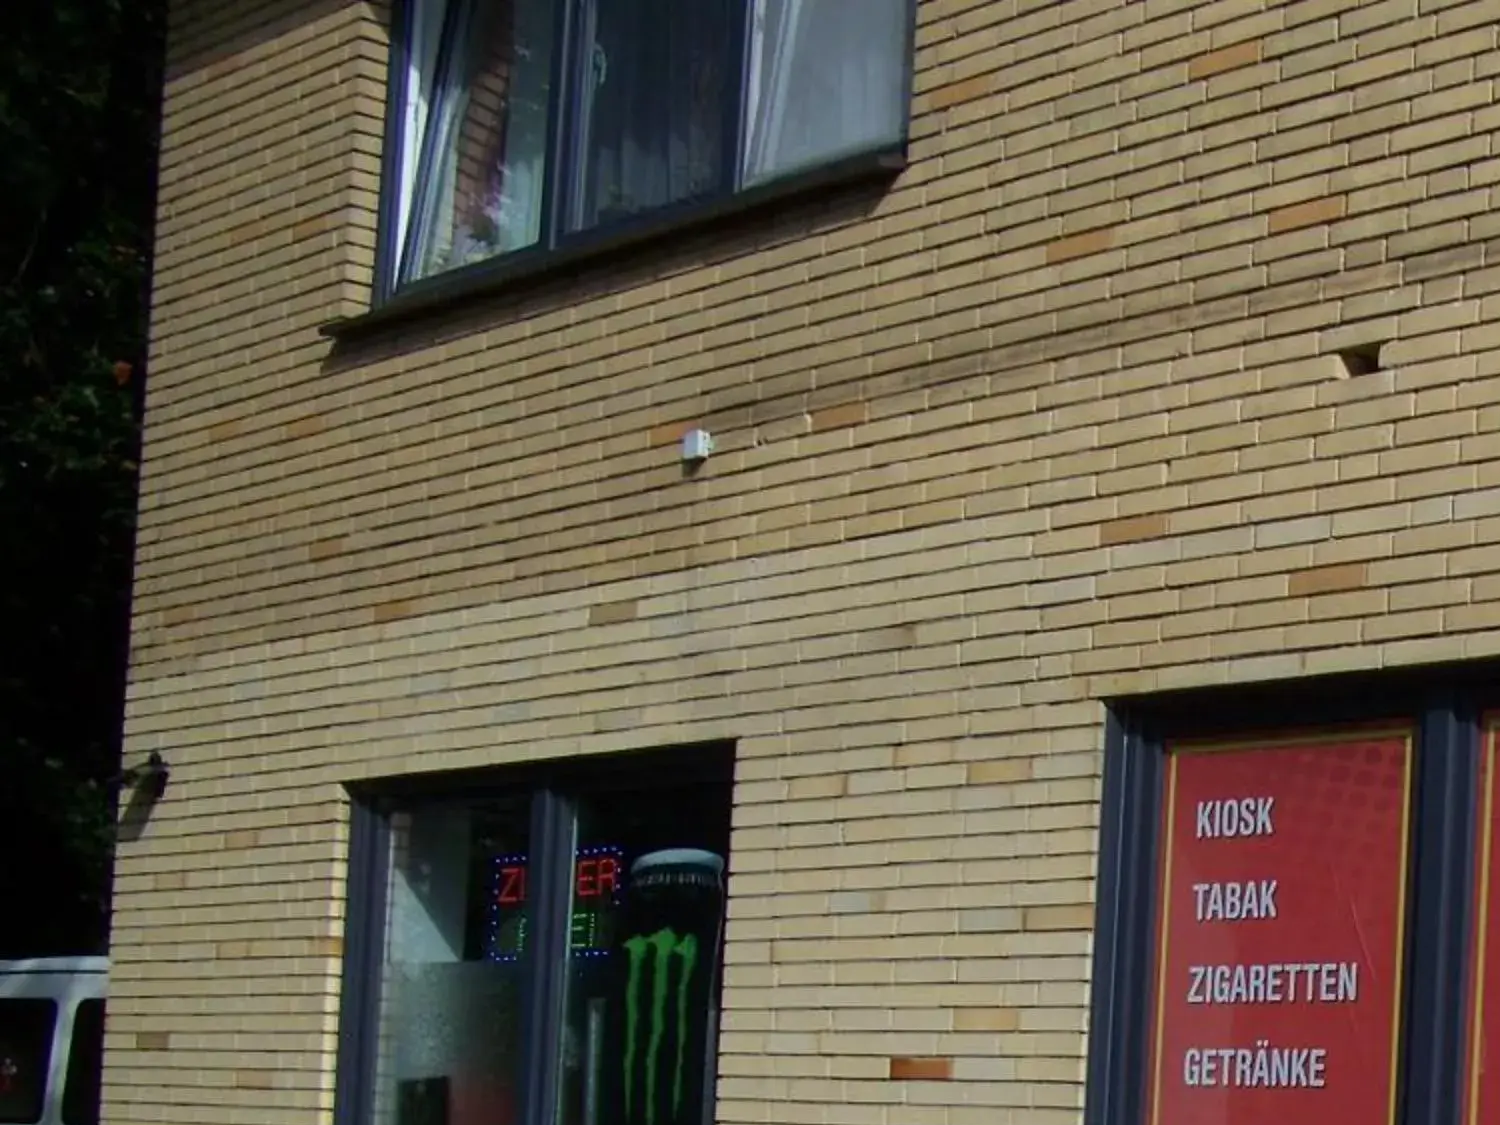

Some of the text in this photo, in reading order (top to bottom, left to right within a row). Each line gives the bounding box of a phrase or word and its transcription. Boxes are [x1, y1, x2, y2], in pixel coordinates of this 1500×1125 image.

[1195, 797, 1275, 838] KIOSK
[1192, 880, 1278, 921] TABAK
[1186, 962, 1358, 1004] ZIGARETTEN
[1183, 1039, 1327, 1088] GETRÄNKE
